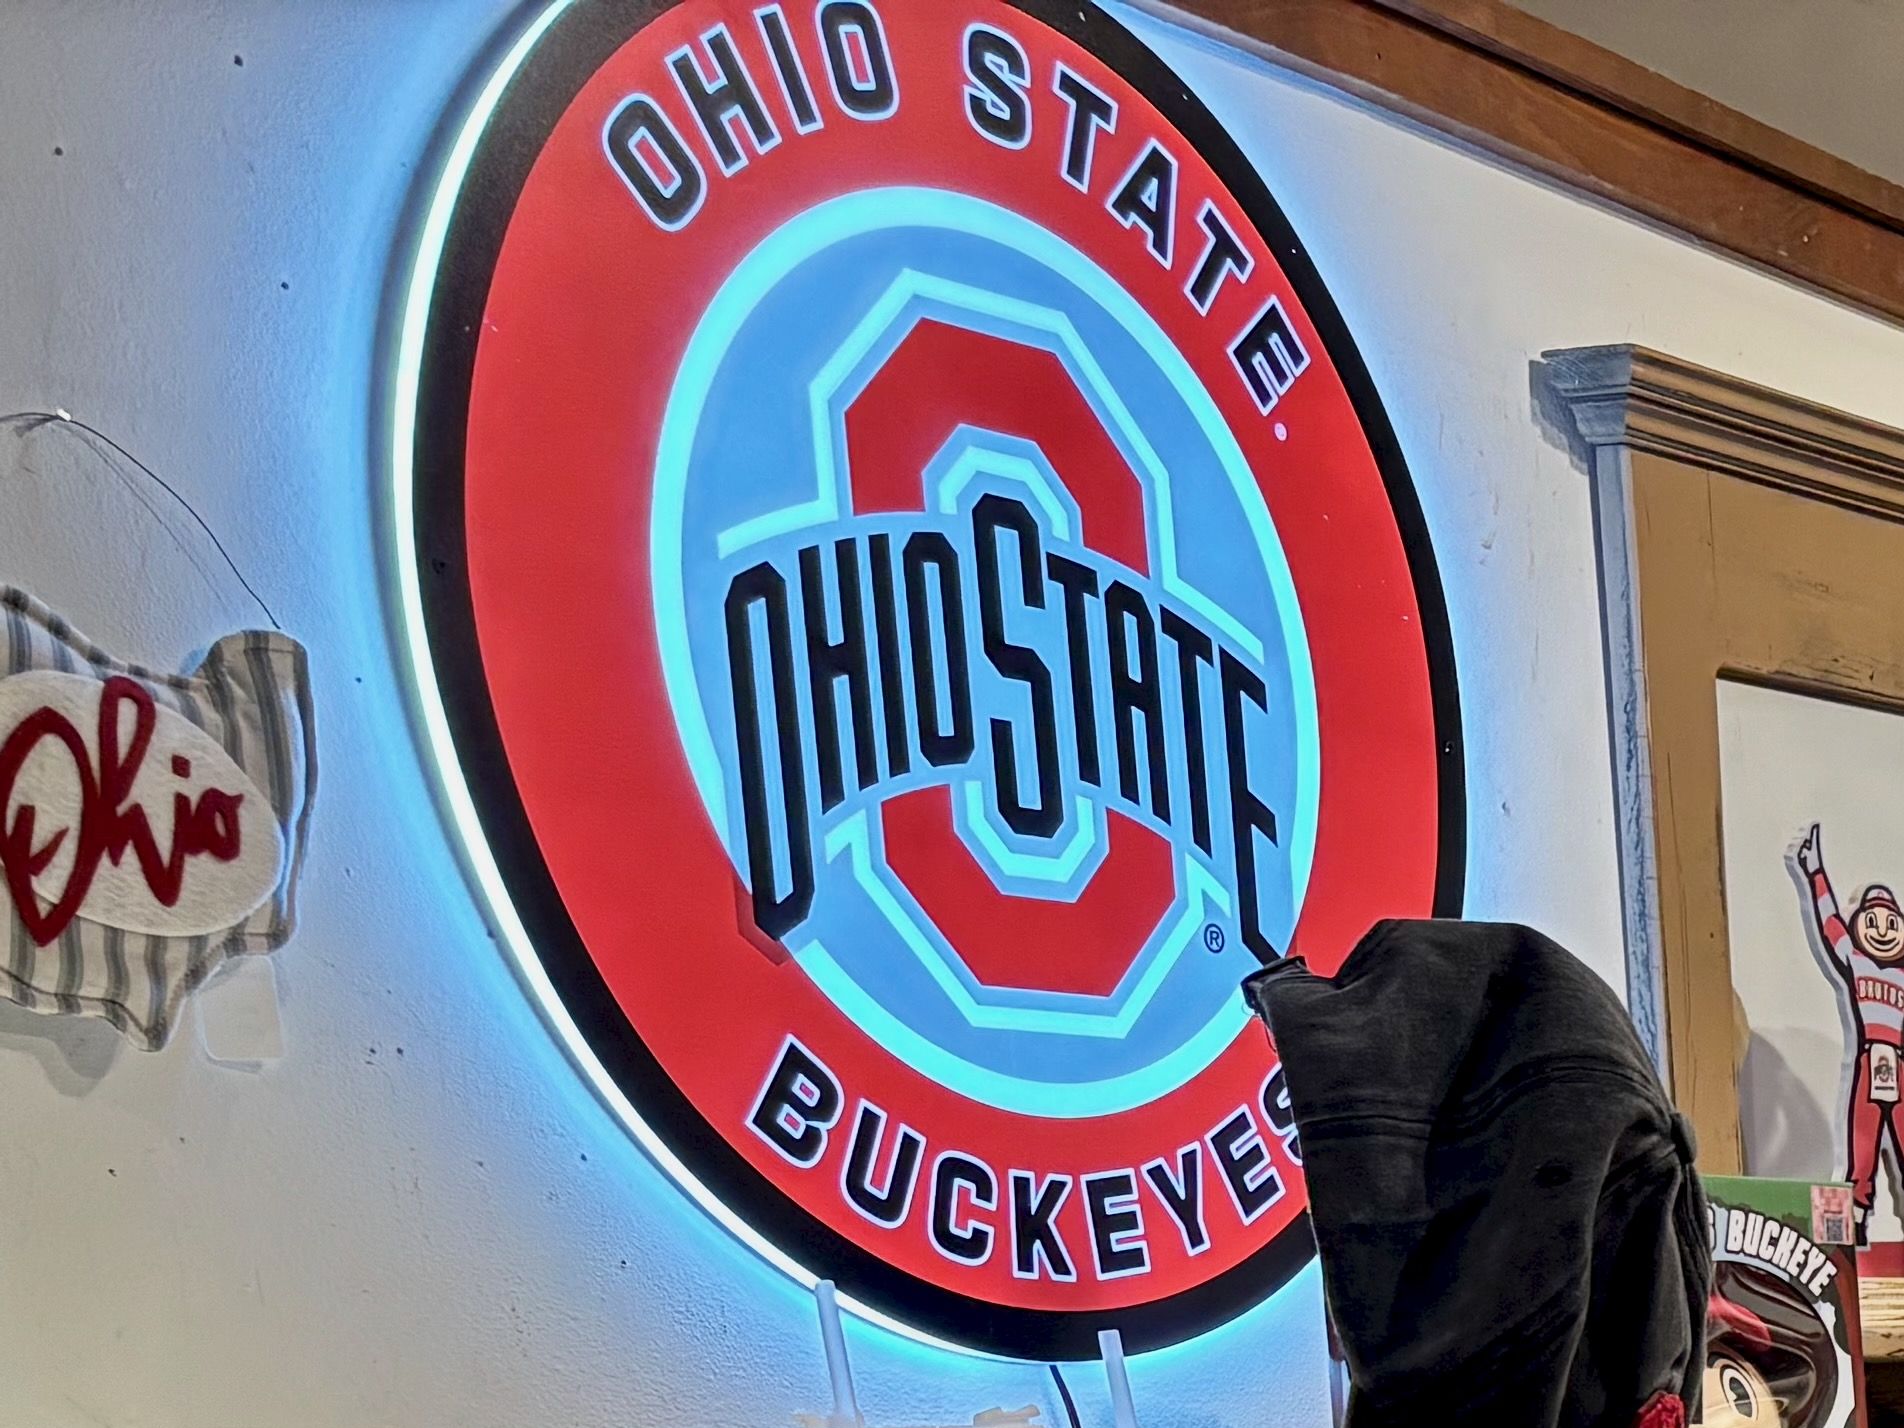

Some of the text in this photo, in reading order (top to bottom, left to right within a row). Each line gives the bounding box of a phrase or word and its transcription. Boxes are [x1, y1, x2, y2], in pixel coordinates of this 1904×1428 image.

[601, 0, 1312, 416] OHIO STATE
[0, 675, 245, 947] Ohio
[1726, 1206, 1838, 1298] BUCKEYE
